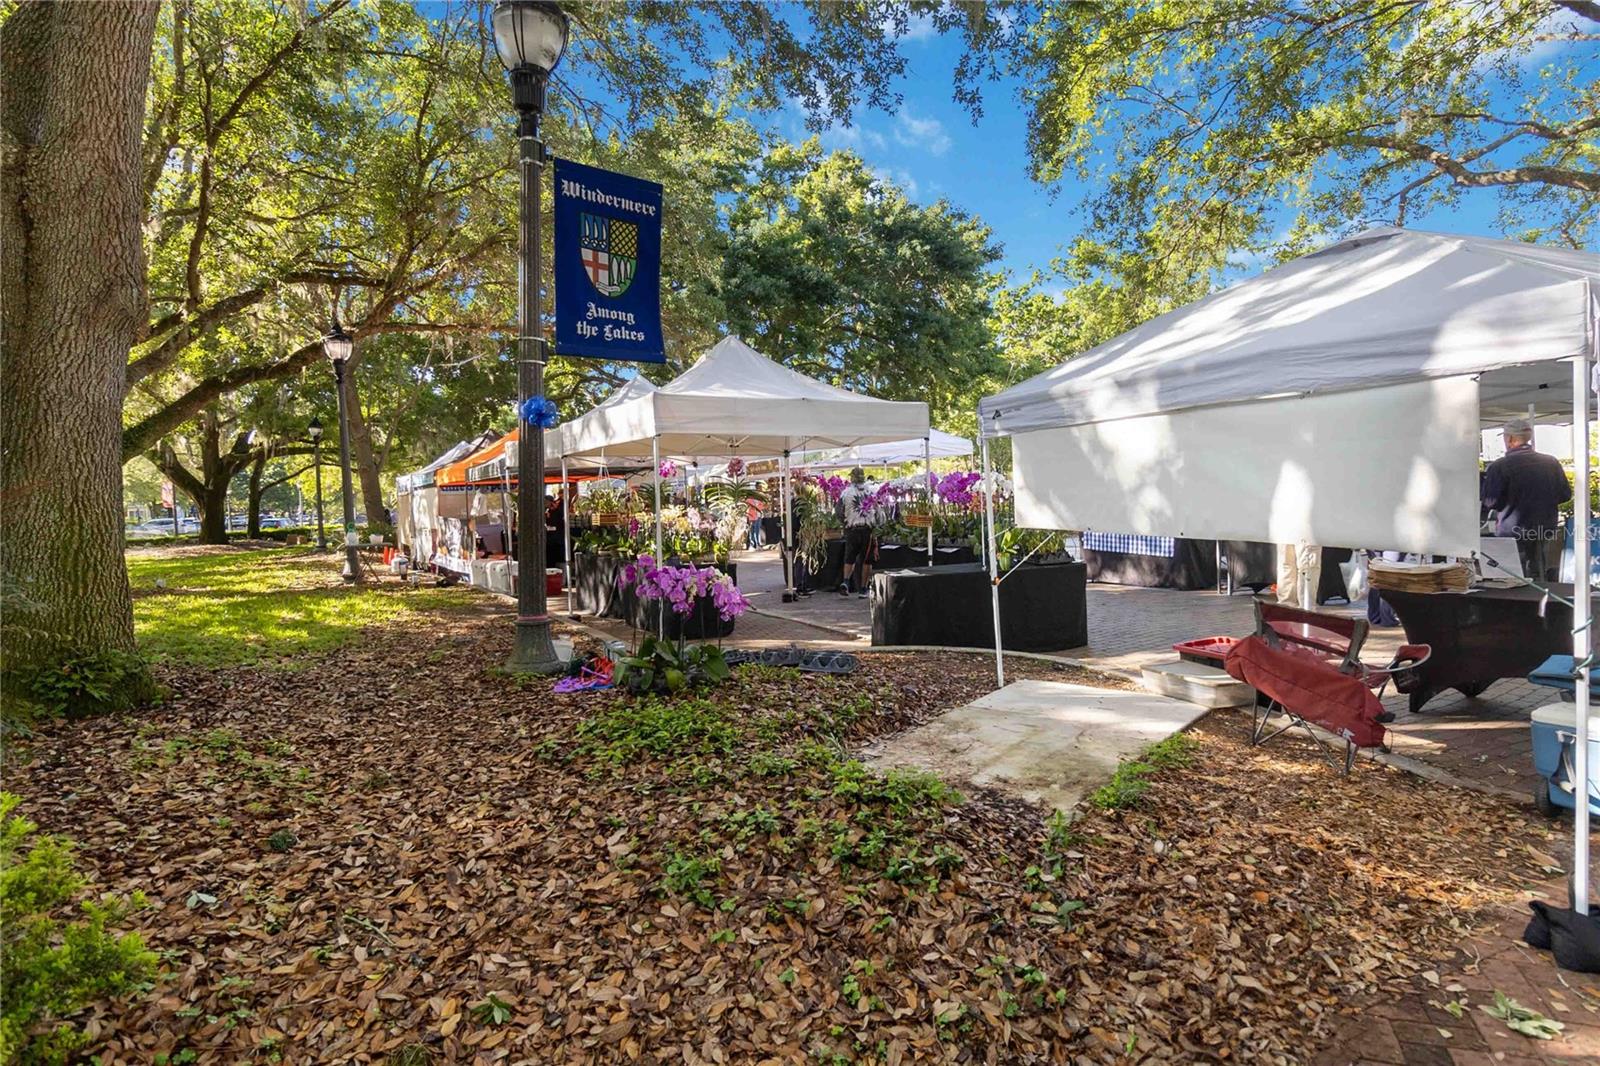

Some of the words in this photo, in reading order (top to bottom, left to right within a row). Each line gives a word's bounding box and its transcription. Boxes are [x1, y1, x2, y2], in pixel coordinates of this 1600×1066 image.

[561, 178, 656, 216] Windermere
[586, 301, 635, 325] Among
[576, 320, 599, 339] the
[603, 324, 645, 341] Lakes
